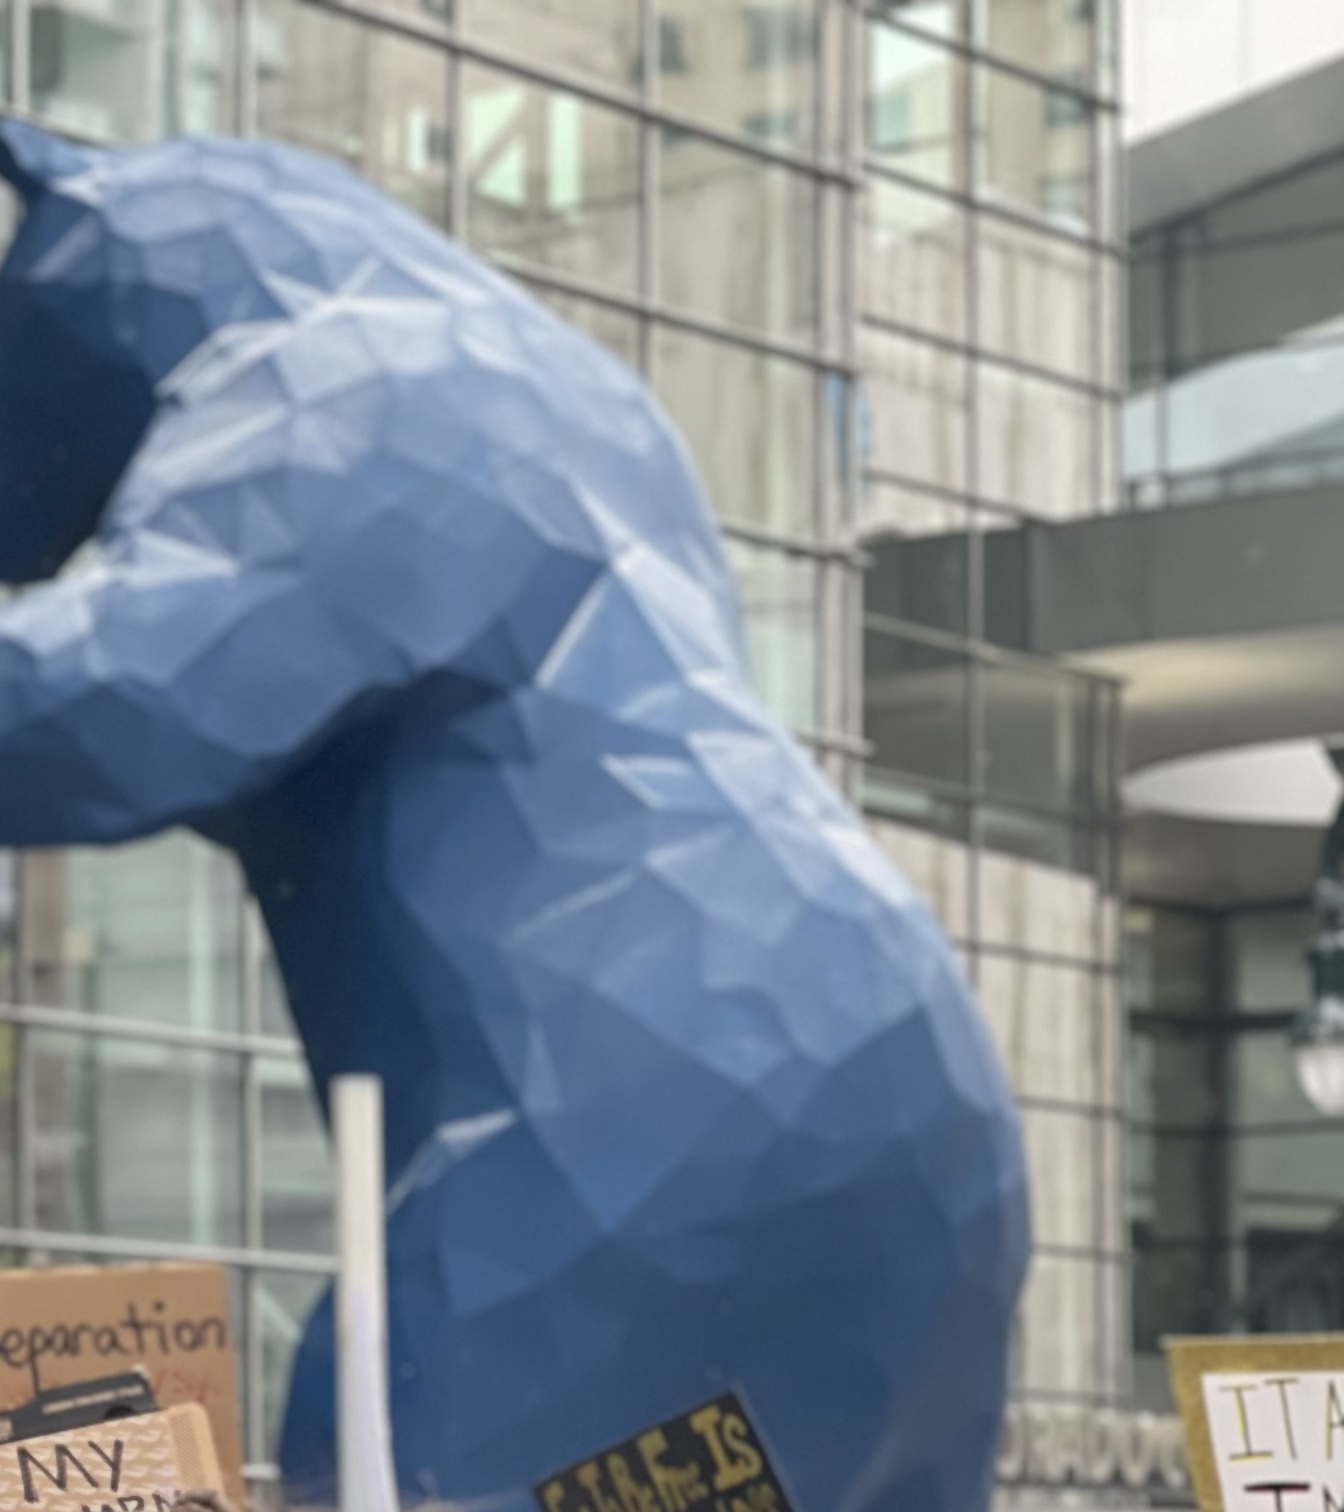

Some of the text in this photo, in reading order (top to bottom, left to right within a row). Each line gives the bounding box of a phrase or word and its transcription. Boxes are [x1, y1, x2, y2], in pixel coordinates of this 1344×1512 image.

[689, 1405, 764, 1493] Is
[1218, 1378, 1299, 1461] IT
[16, 1440, 125, 1503] MY
